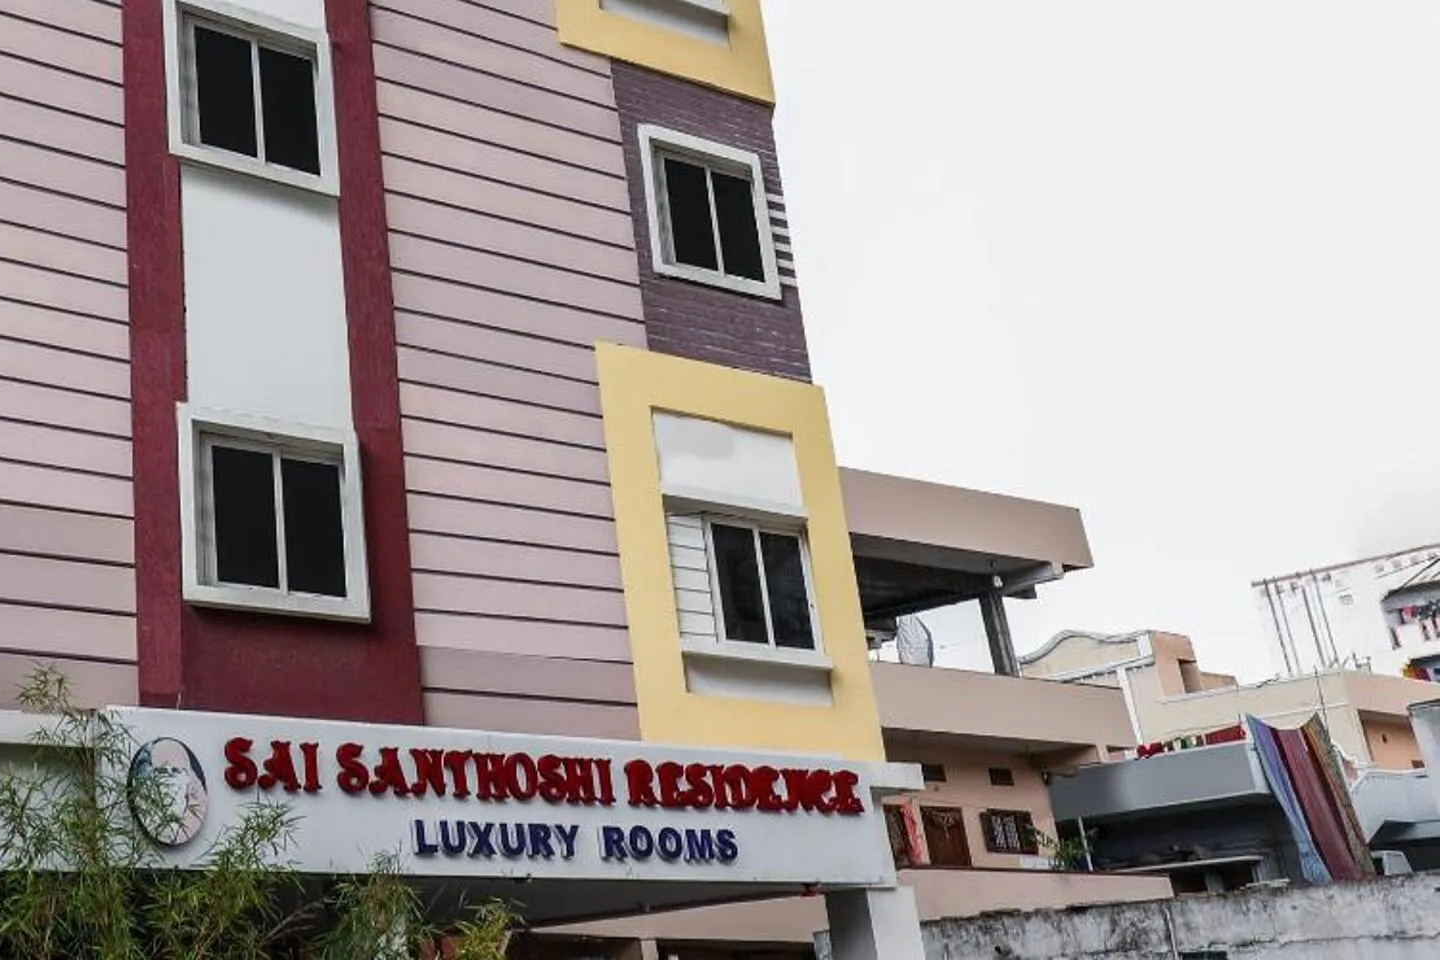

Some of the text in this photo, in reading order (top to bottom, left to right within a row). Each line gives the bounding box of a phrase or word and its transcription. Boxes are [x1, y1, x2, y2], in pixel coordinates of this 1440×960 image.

[224, 737, 865, 815] SAI SANTHOSHI RESIDENCE
[413, 819, 738, 862] LUXURY ROOMS
